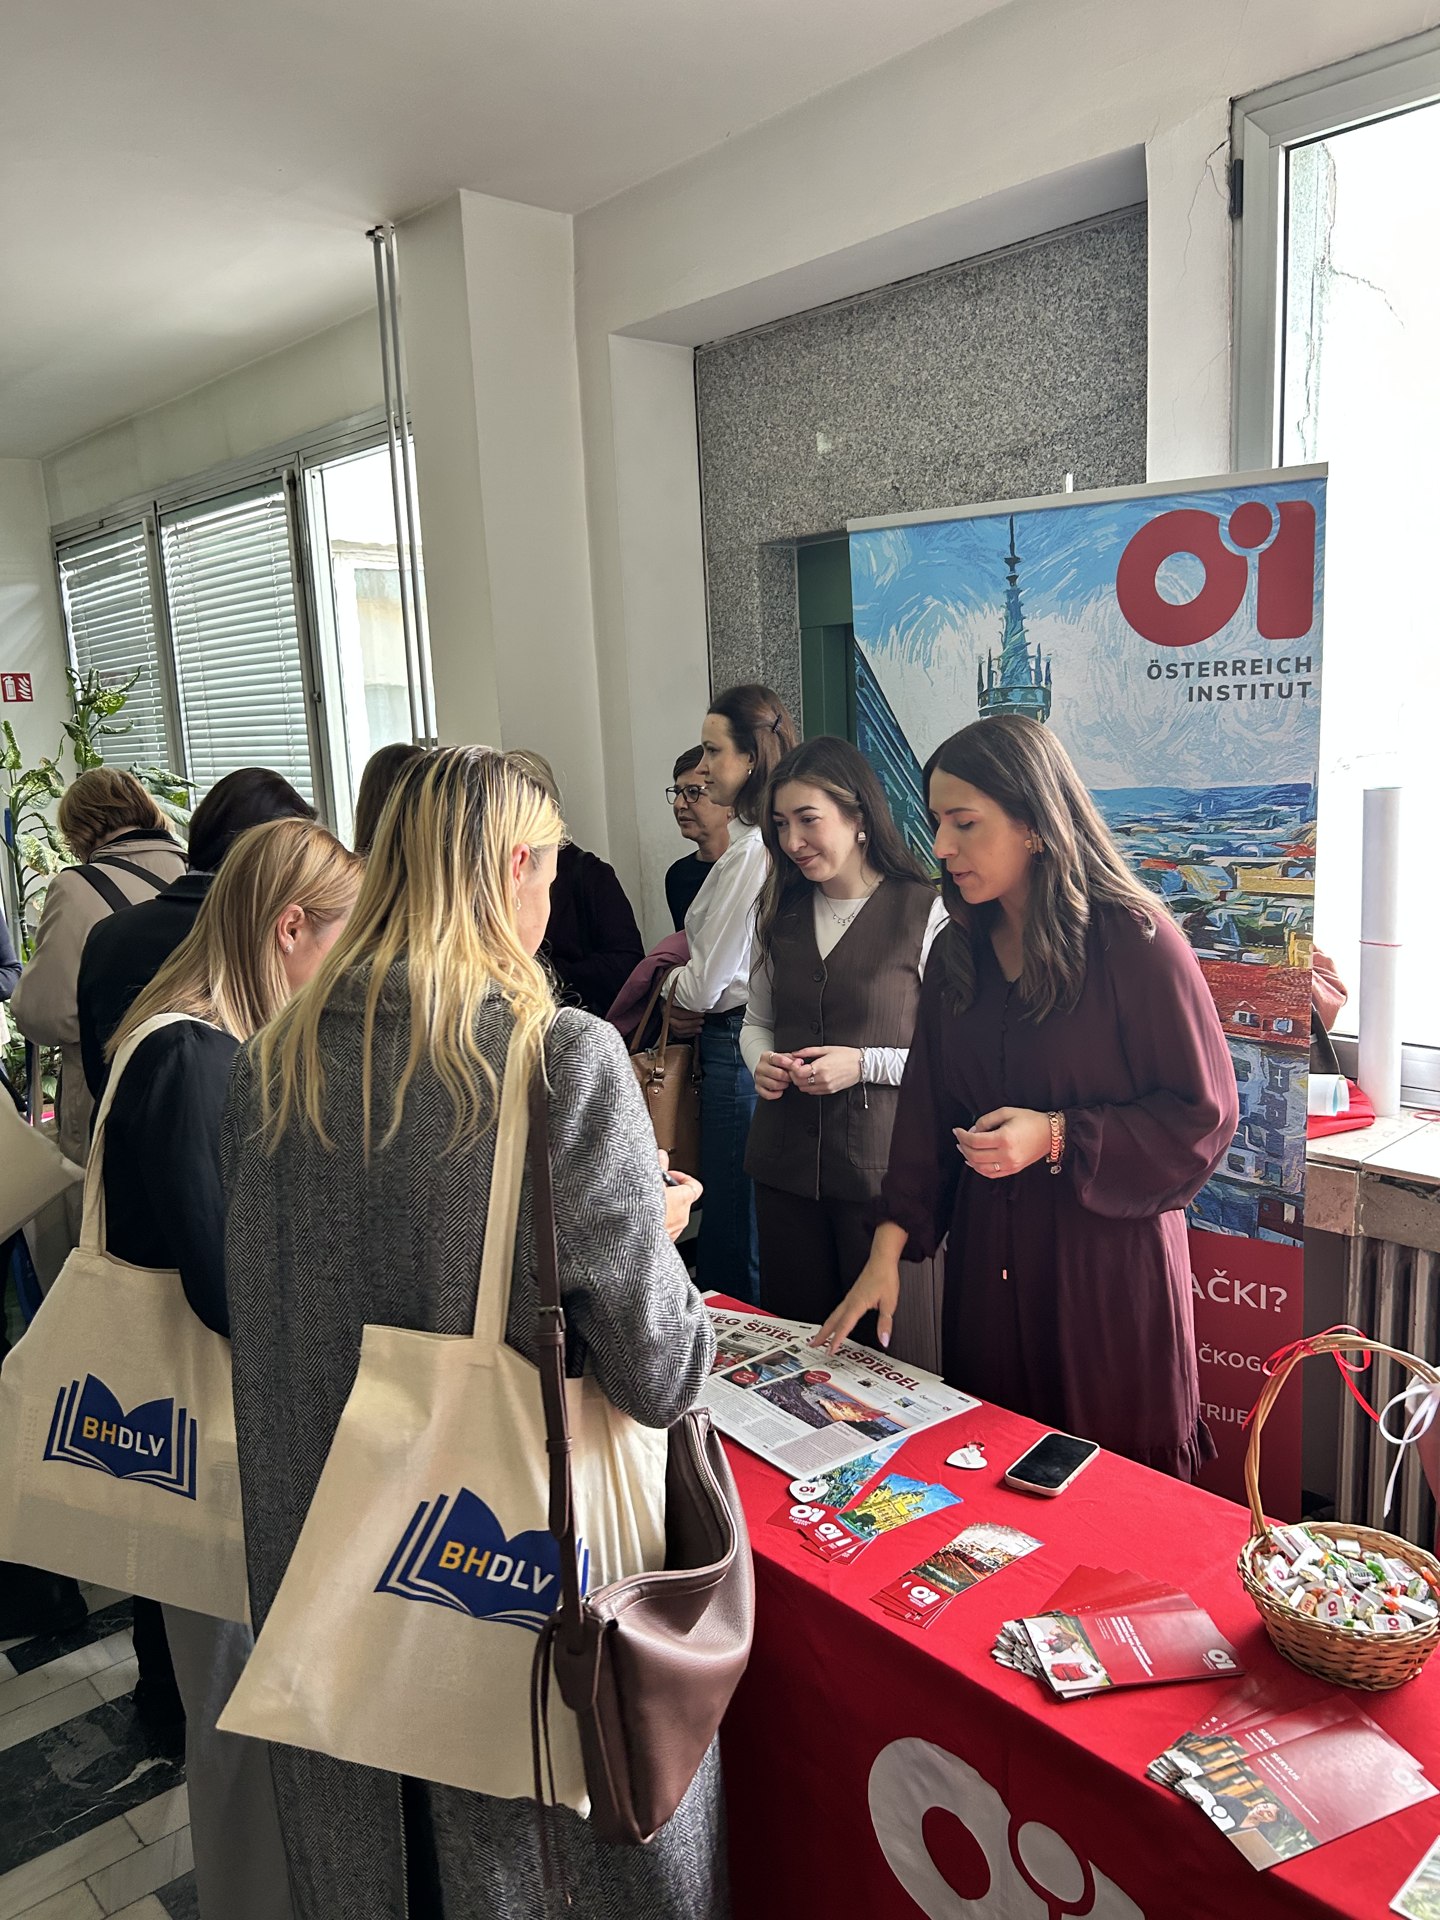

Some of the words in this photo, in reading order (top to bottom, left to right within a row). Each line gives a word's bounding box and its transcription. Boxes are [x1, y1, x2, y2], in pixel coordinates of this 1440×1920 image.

[1146, 656, 1313, 680] ÖSTERREICH
[1188, 681, 1313, 702] INSTITUT
[1191, 1268, 1288, 1312] AČKI?
[850, 1348, 921, 1391] SPIEGEL
[1198, 1342, 1262, 1372] ČKOG
[1199, 1402, 1249, 1426] TRIJE
[82, 1416, 165, 1457] BHDLV
[439, 1541, 555, 1595] BHDLV
[1258, 1728, 1279, 1746] SERV
[1270, 1752, 1300, 1781] SERVUS
